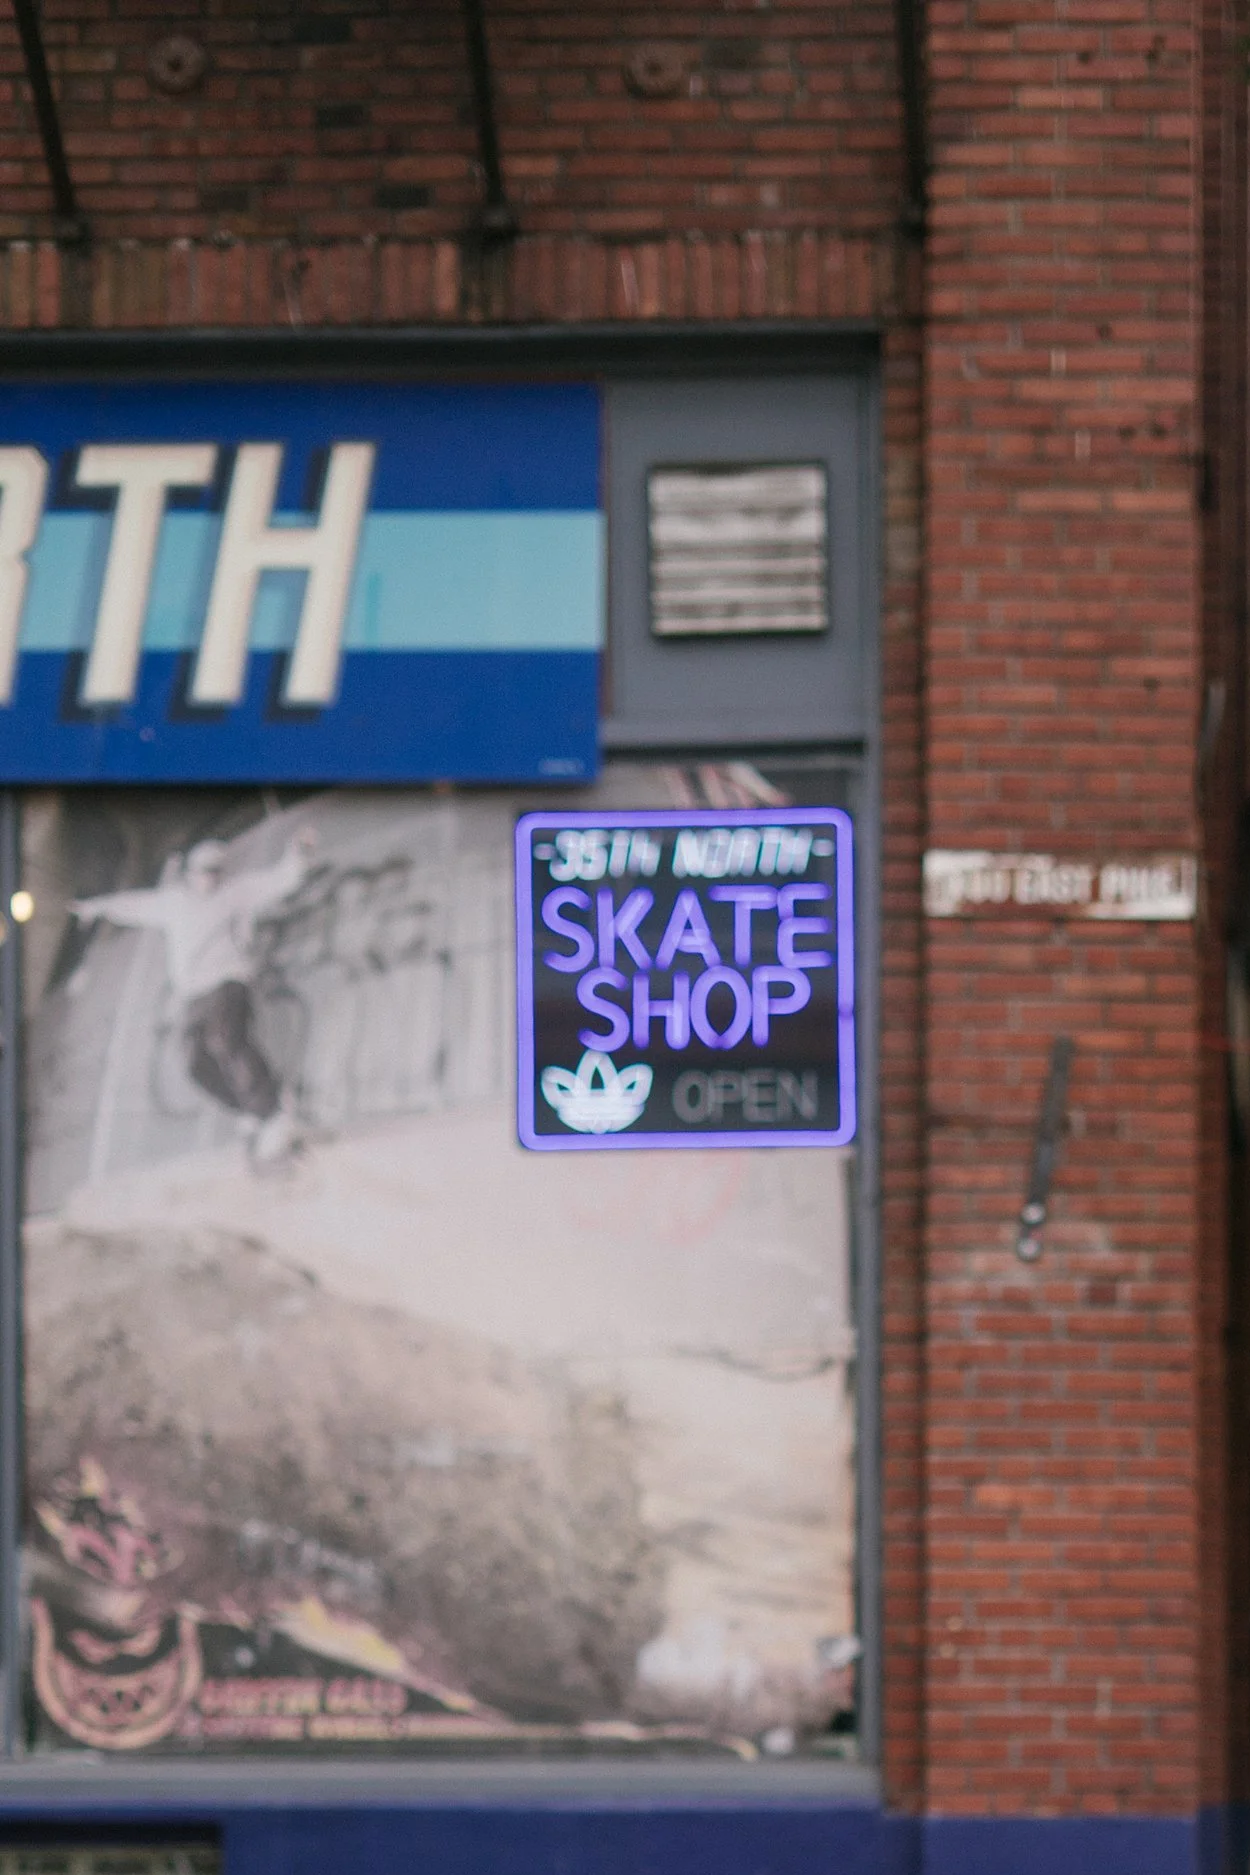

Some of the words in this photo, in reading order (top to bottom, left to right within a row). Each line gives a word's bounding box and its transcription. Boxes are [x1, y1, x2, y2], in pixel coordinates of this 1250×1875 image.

[0, 441, 376, 708] TH
[541, 883, 832, 973] SKATE
[576, 965, 812, 1052] SHOP
[672, 1068, 819, 1123] OPEN
